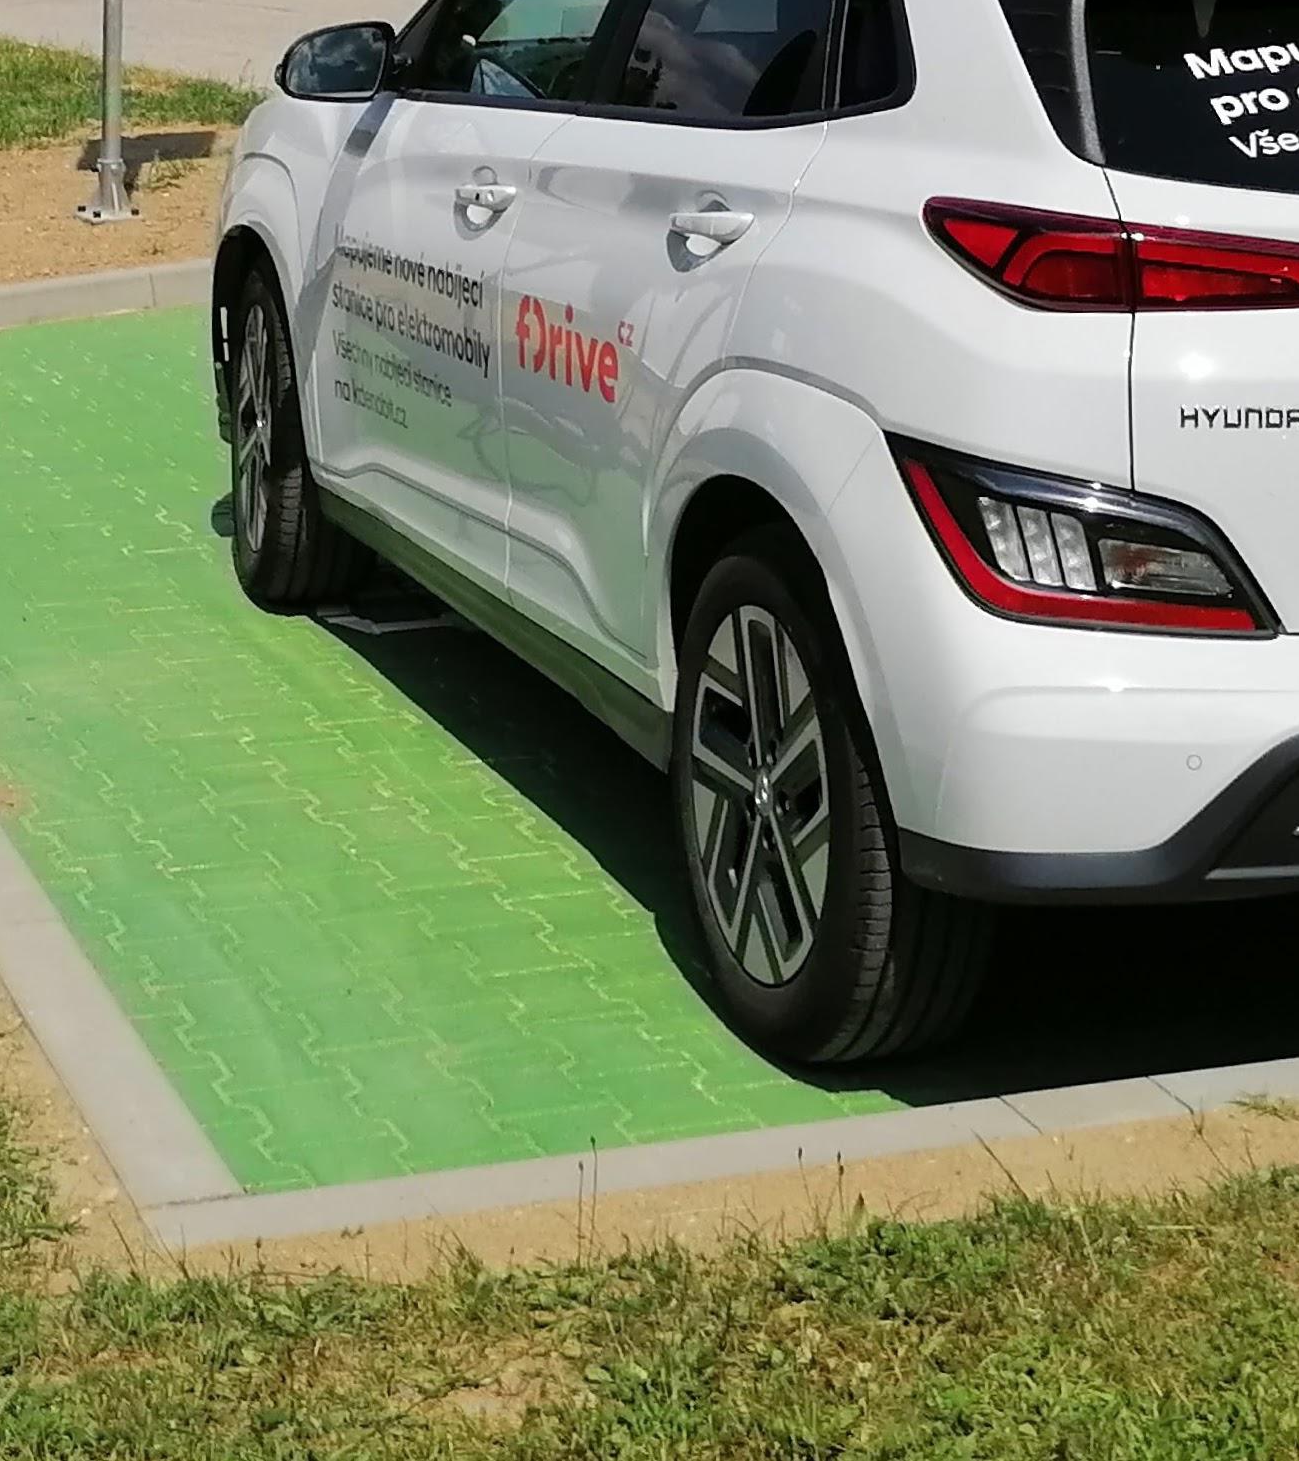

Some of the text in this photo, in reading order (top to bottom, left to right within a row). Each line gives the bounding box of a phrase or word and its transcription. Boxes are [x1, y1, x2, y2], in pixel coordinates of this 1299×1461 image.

[1210, 88, 1290, 124] pro
[395, 251, 424, 288] nové
[332, 280, 490, 378] stanice pro elektromobily
[334, 379, 351, 402] na
